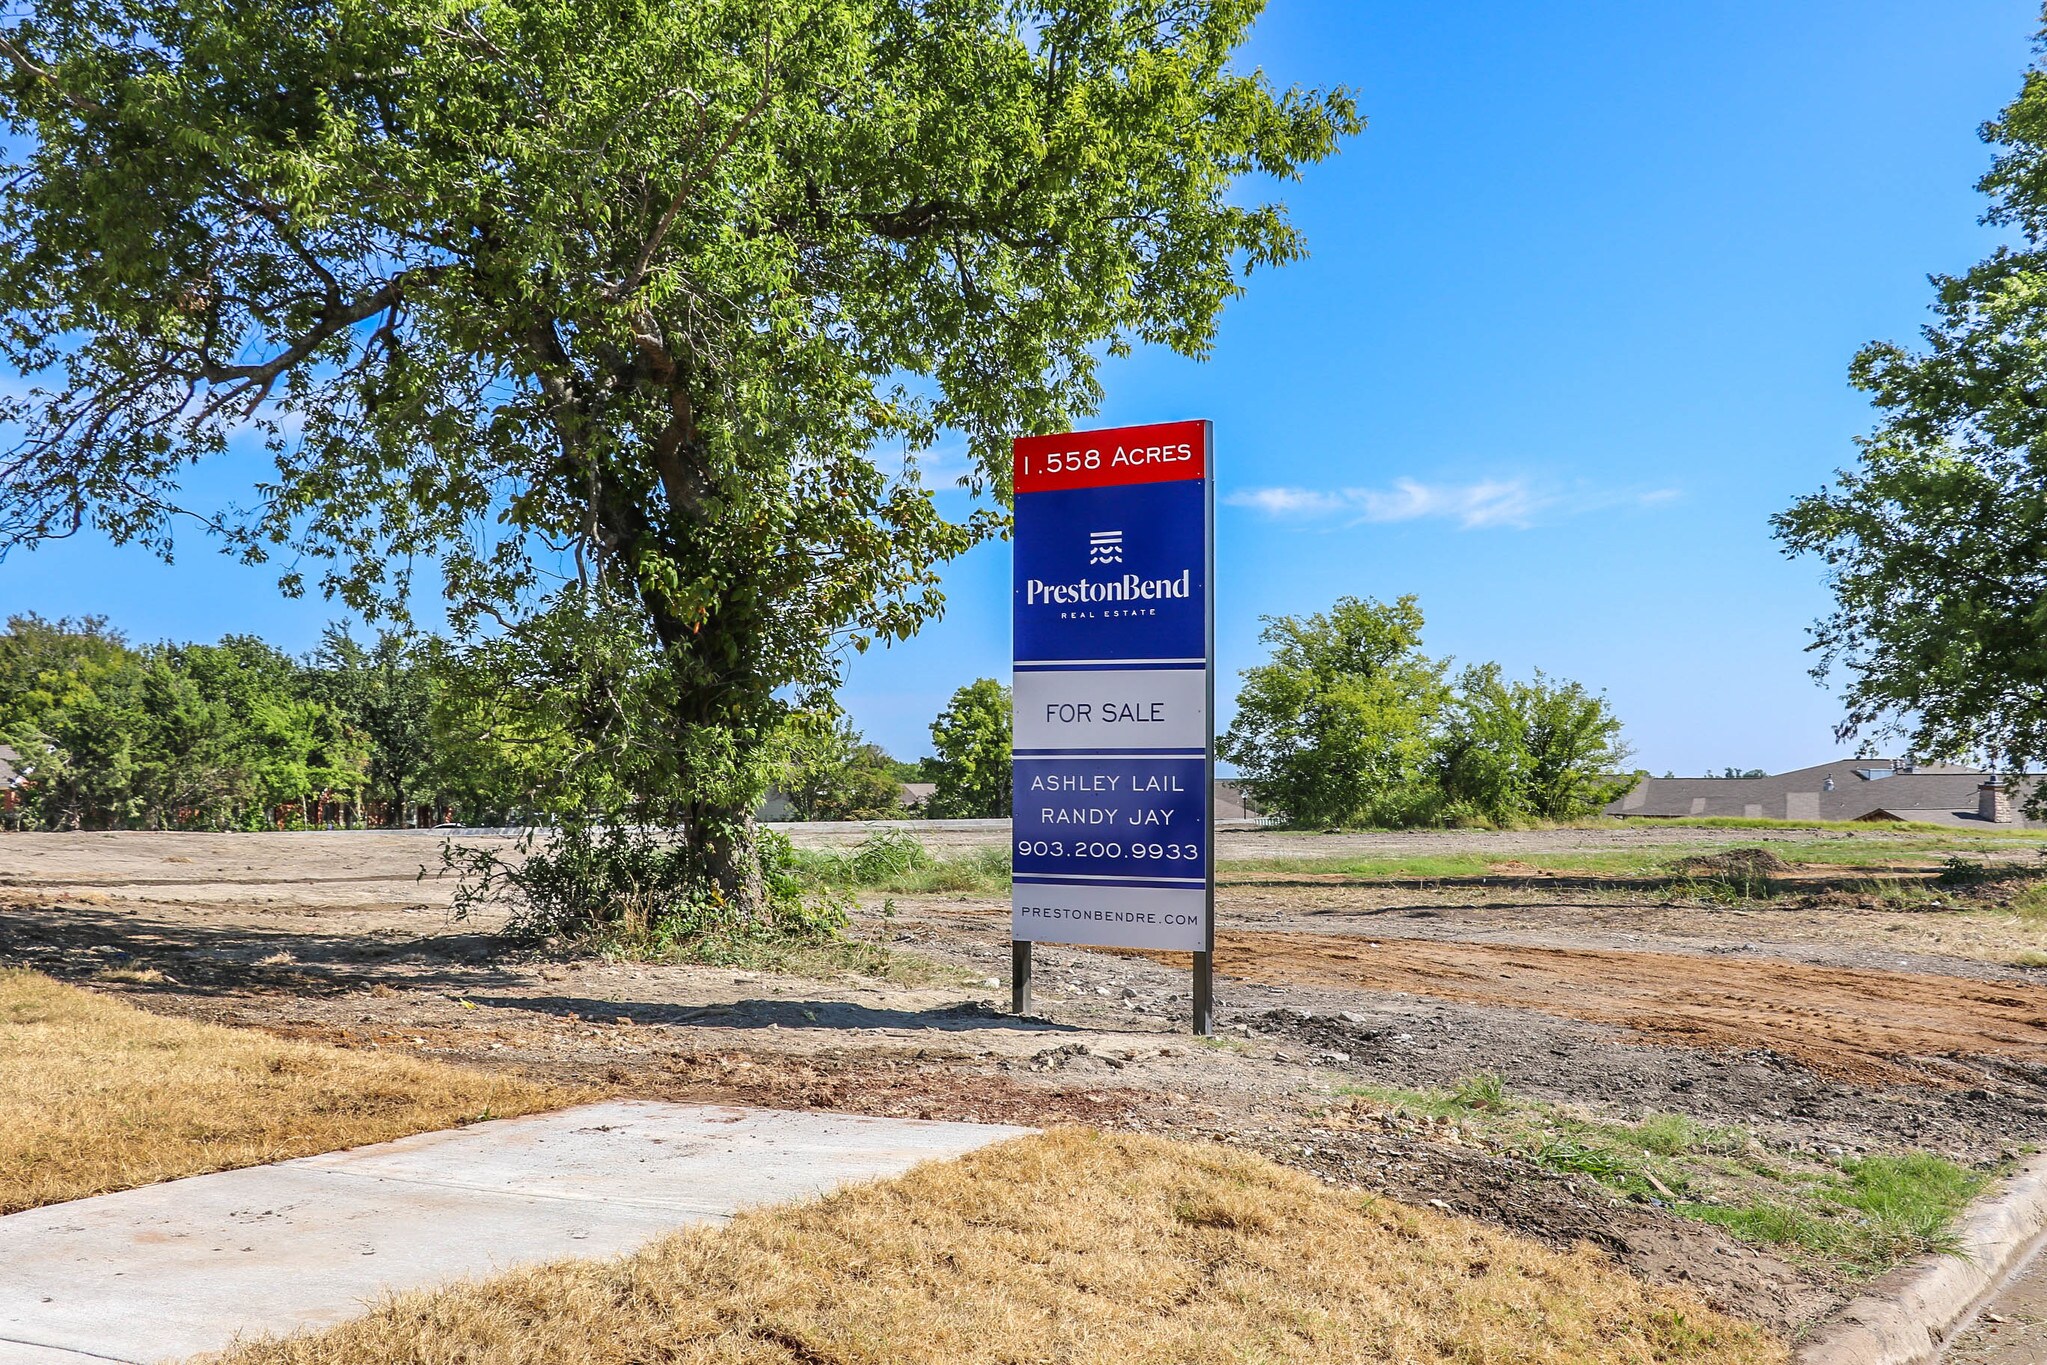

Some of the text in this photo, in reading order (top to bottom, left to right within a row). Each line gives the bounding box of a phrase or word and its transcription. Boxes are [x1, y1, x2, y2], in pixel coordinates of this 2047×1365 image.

[1027, 569, 1190, 605] PrestonBend
[1061, 608, 1156, 619] REAL ESTATE
[1046, 702, 1165, 723] FOR SALE
[1030, 775, 1185, 792] ASHLEY LAIL
[1041, 808, 1175, 826] RANDY JAY
[1018, 840, 1199, 860] 903.200.9933
[1021, 906, 1199, 926] PRESTONBENDRE.COM
